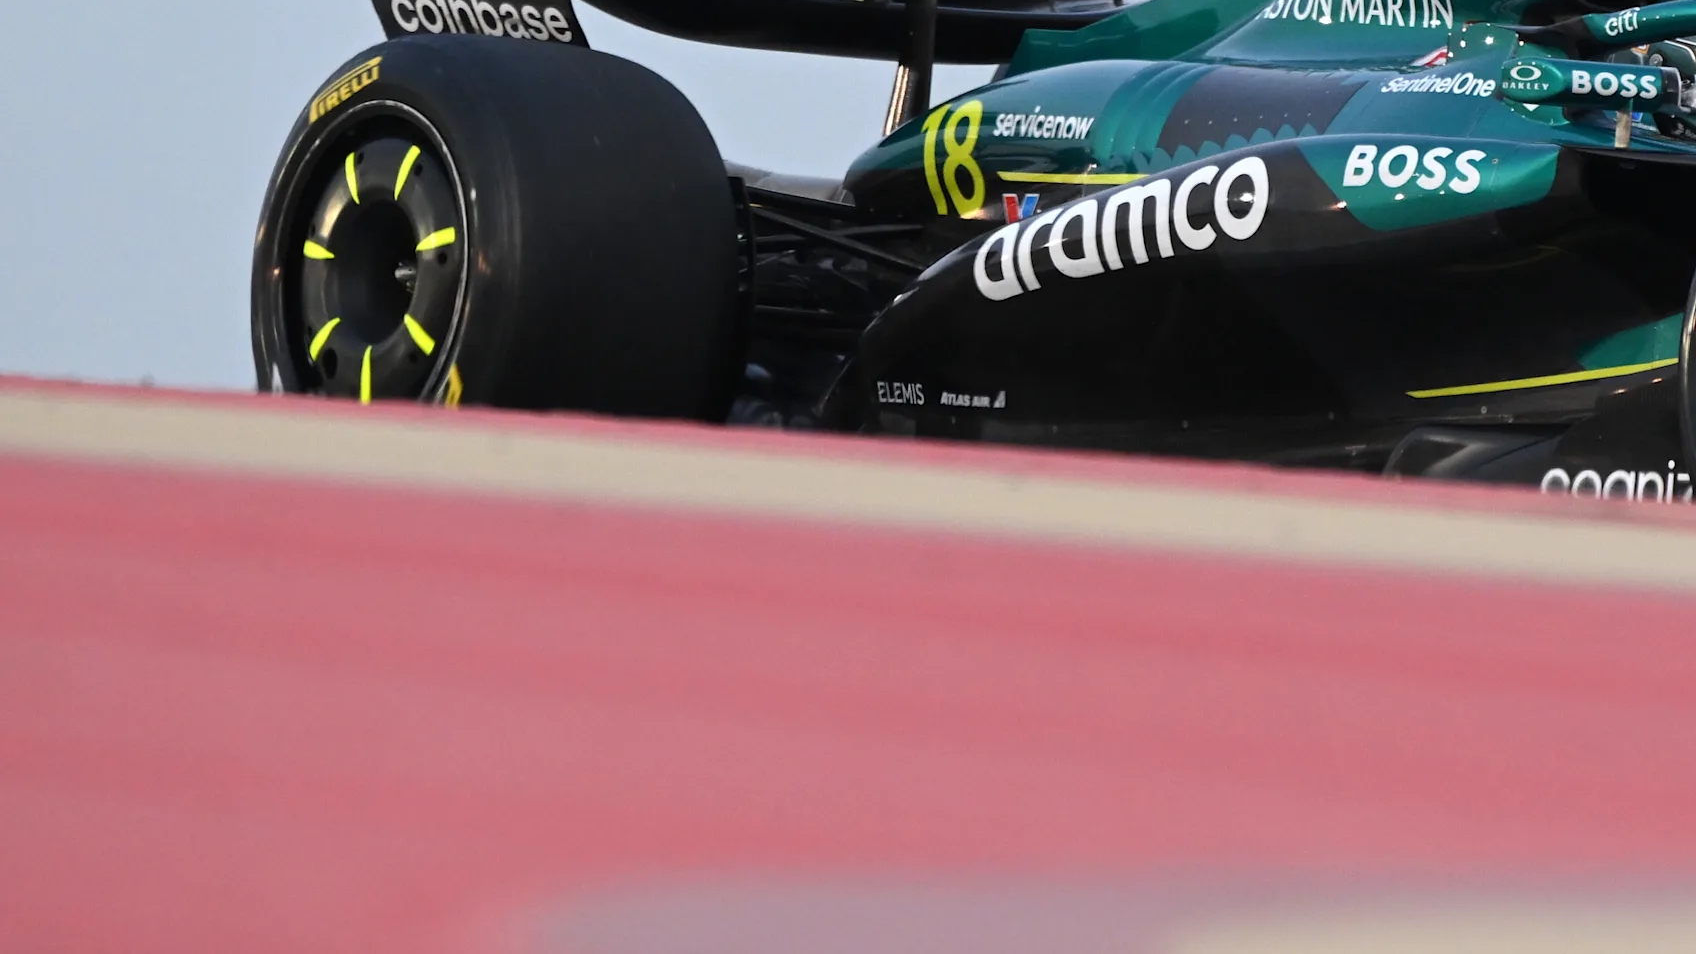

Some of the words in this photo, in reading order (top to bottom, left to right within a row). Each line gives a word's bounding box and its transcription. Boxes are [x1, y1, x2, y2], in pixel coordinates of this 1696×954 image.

[1604, 7, 1641, 37] citi
[308, 55, 383, 124] PIRELLI
[1381, 72, 1496, 97] SentinelOne
[1502, 81, 1550, 91] OAKLEY
[1571, 70, 1658, 100] BOSS
[993, 105, 1096, 140] servicenow
[920, 99, 986, 220] 18
[1342, 144, 1487, 195] BOSS
[972, 155, 1270, 302] aramco
[877, 381, 925, 405] ELEMIS
[940, 392, 971, 407] ATLAS
[971, 396, 990, 407] AIR
